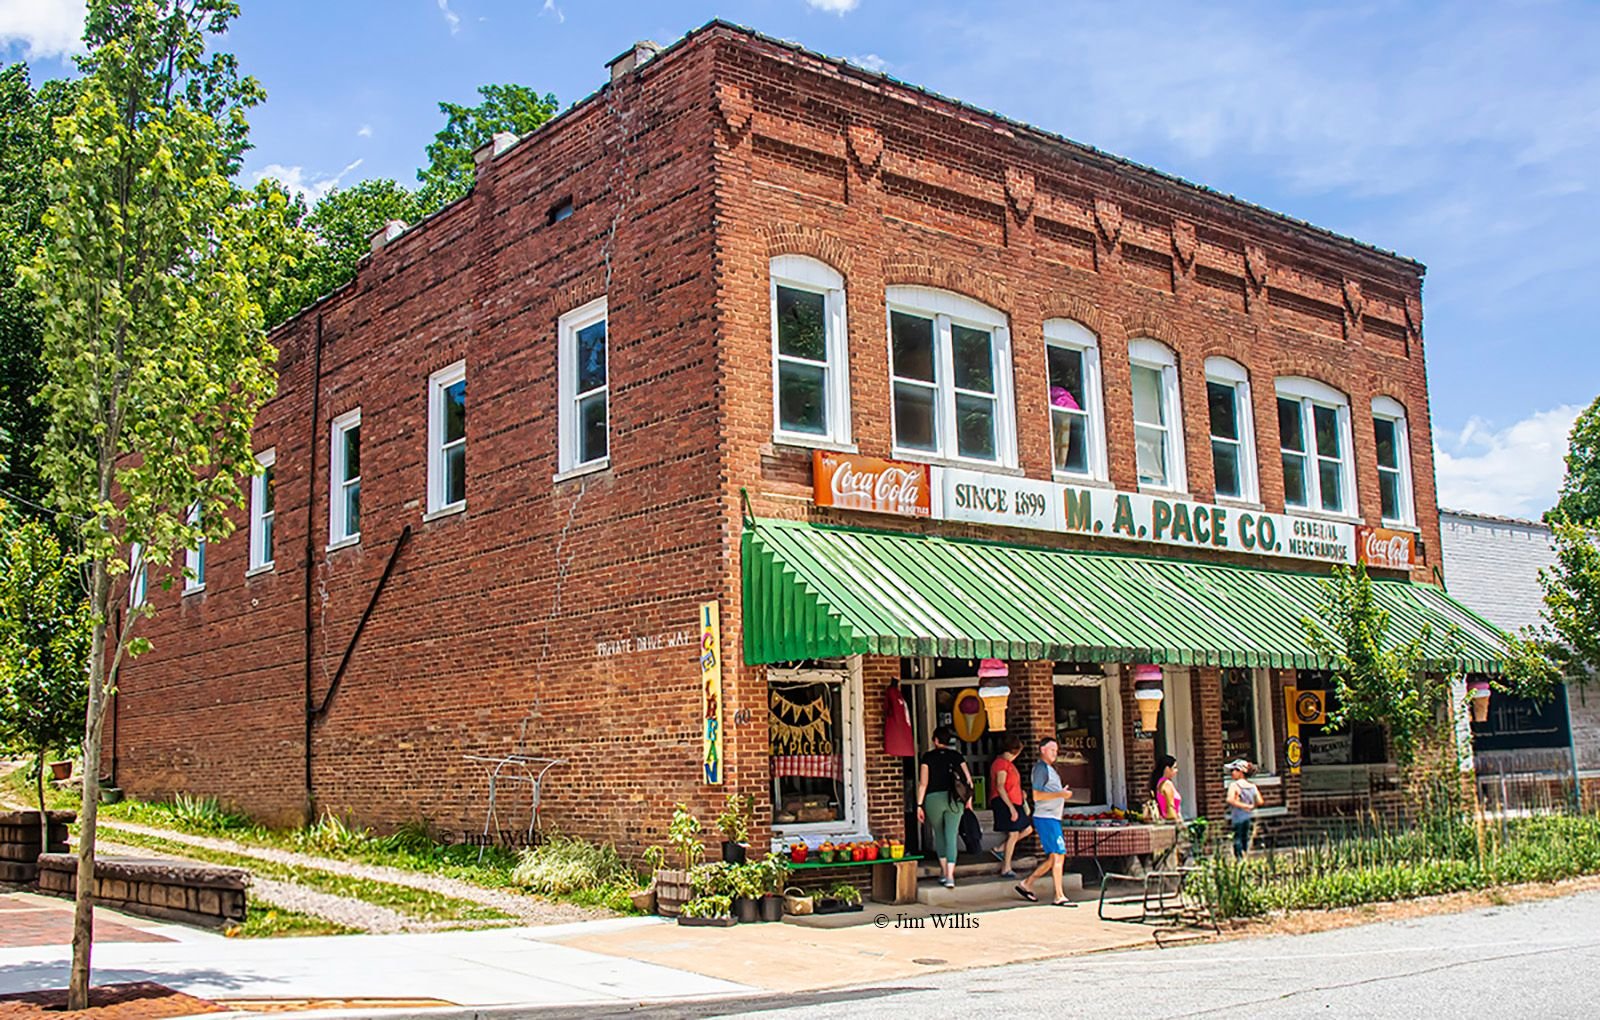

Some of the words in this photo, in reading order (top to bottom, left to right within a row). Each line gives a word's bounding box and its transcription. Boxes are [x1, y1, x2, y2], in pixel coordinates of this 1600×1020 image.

[955, 483, 1008, 513] SINCE
[1014, 490, 1046, 517] 1899
[1064, 488, 1104, 533] M.
[1112, 494, 1147, 538] A.
[1152, 499, 1229, 547] PACE
[1238, 513, 1282, 552] CO.
[1289, 538, 1348, 560] MERCHANDISE
[636, 634, 665, 652] DRIVE
[668, 631, 690, 648] WAY
[789, 741, 816, 755] PACE
